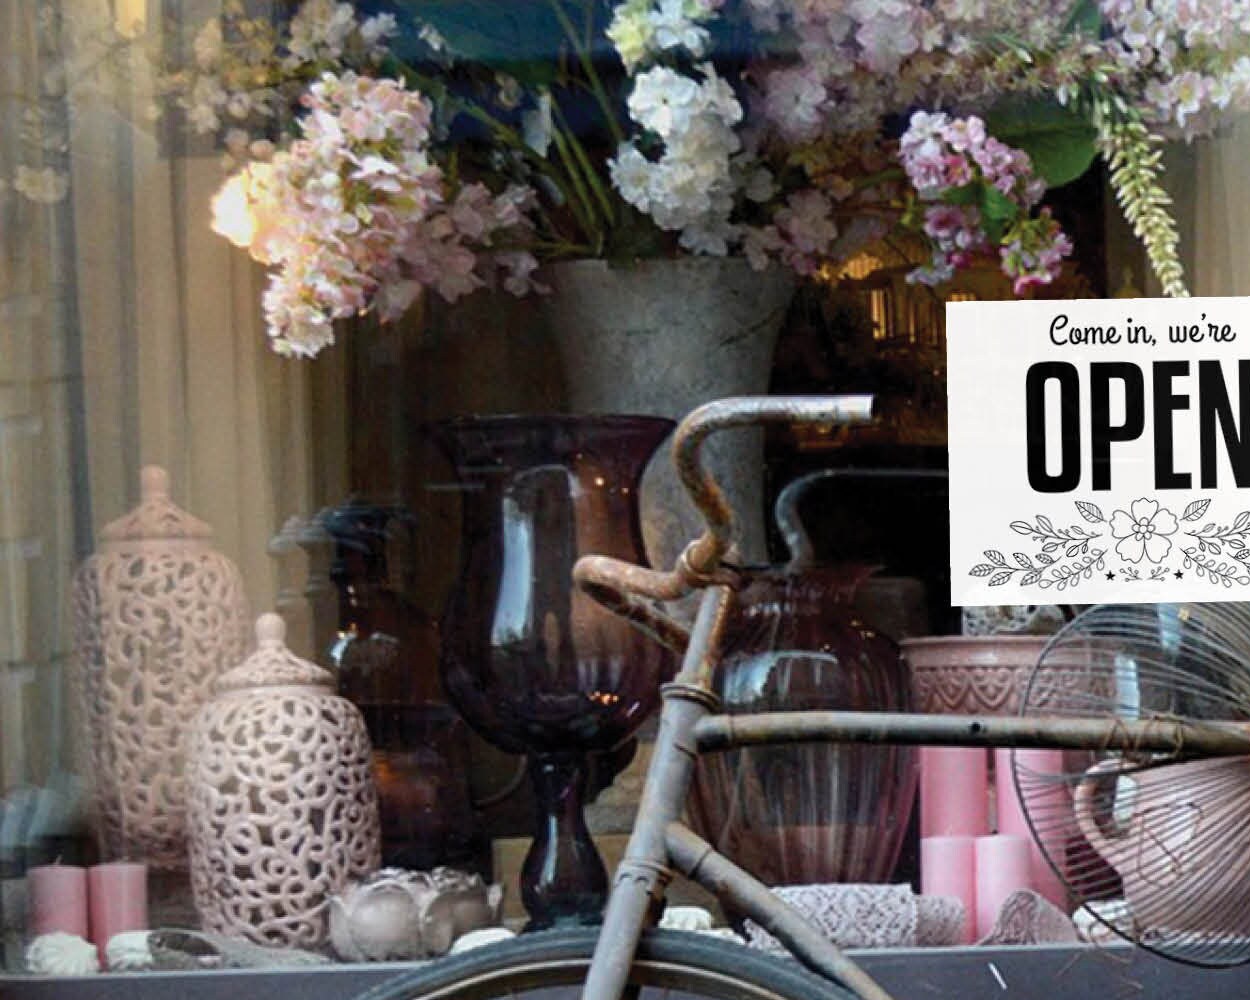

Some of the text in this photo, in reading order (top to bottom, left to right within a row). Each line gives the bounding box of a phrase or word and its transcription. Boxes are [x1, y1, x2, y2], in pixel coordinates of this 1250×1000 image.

[1049, 312, 1237, 347] Come in, we're
